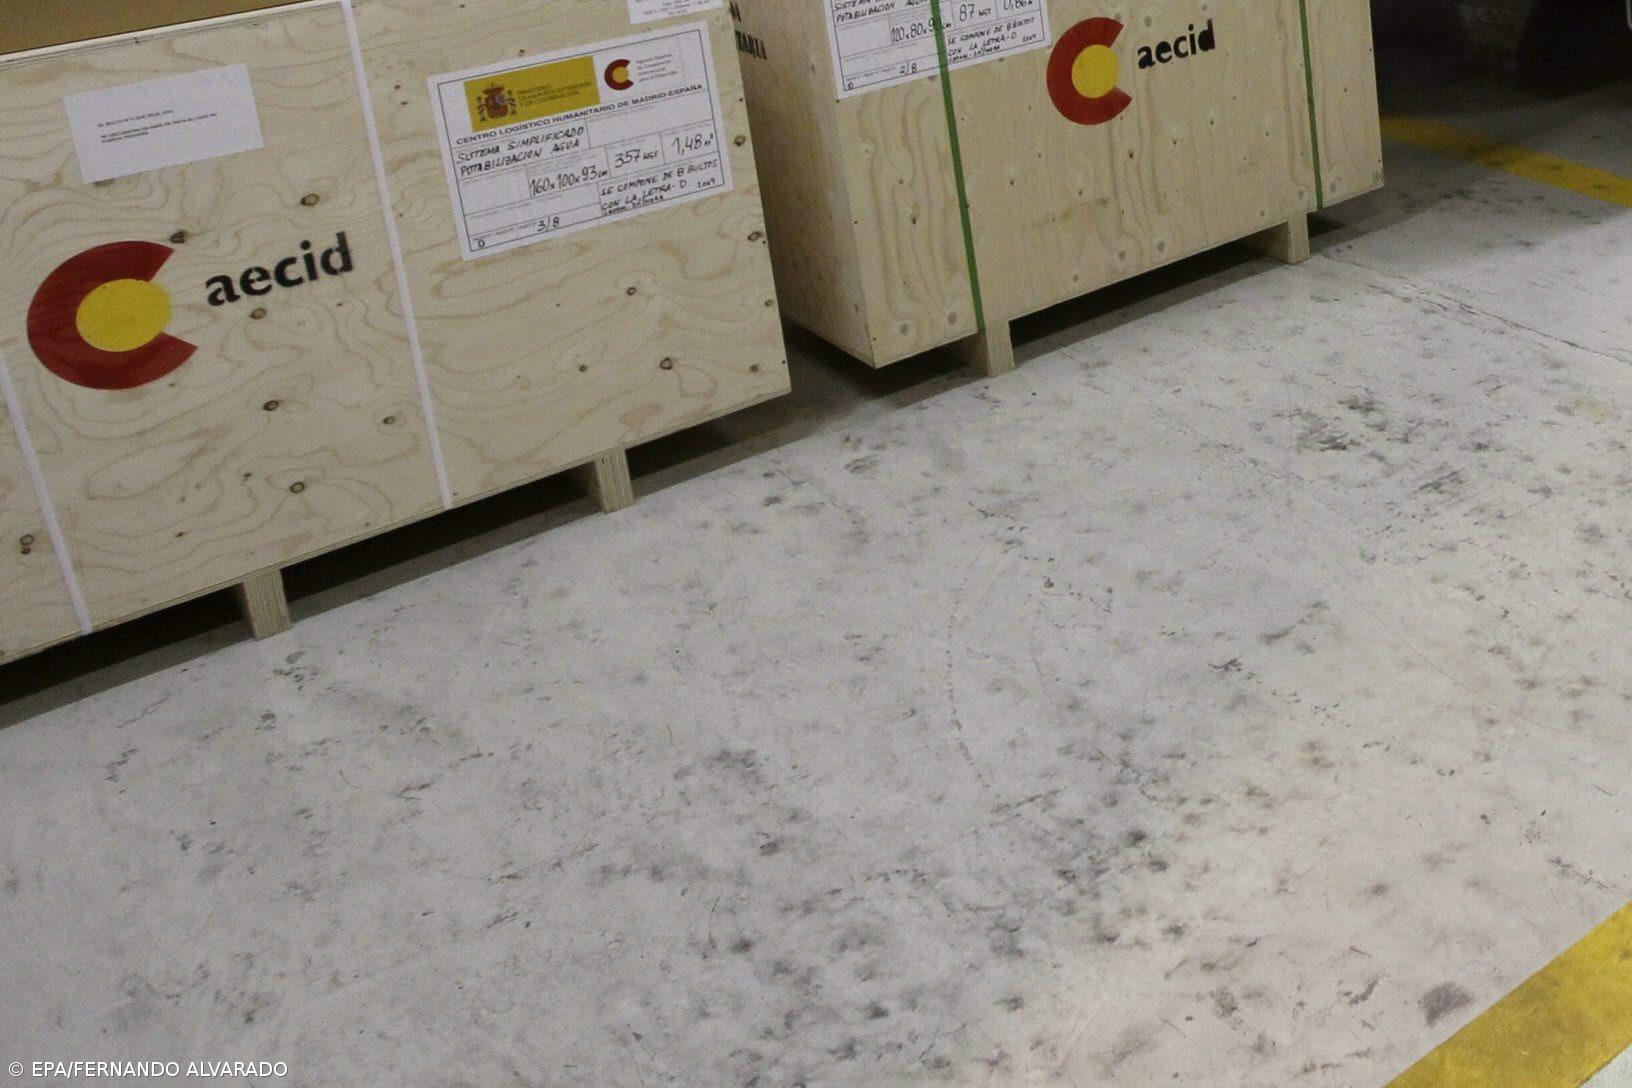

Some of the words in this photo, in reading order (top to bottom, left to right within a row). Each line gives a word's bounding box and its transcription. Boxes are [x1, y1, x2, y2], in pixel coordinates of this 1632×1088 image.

[1137, 18, 1216, 70] aecid
[456, 129, 498, 145] CENTRO
[552, 104, 616, 125] HUMANITARIO
[617, 100, 631, 109] DE
[457, 145, 501, 163] SISTEMA
[507, 125, 584, 151] SIMPLIFICADO
[205, 231, 355, 307] aecid
